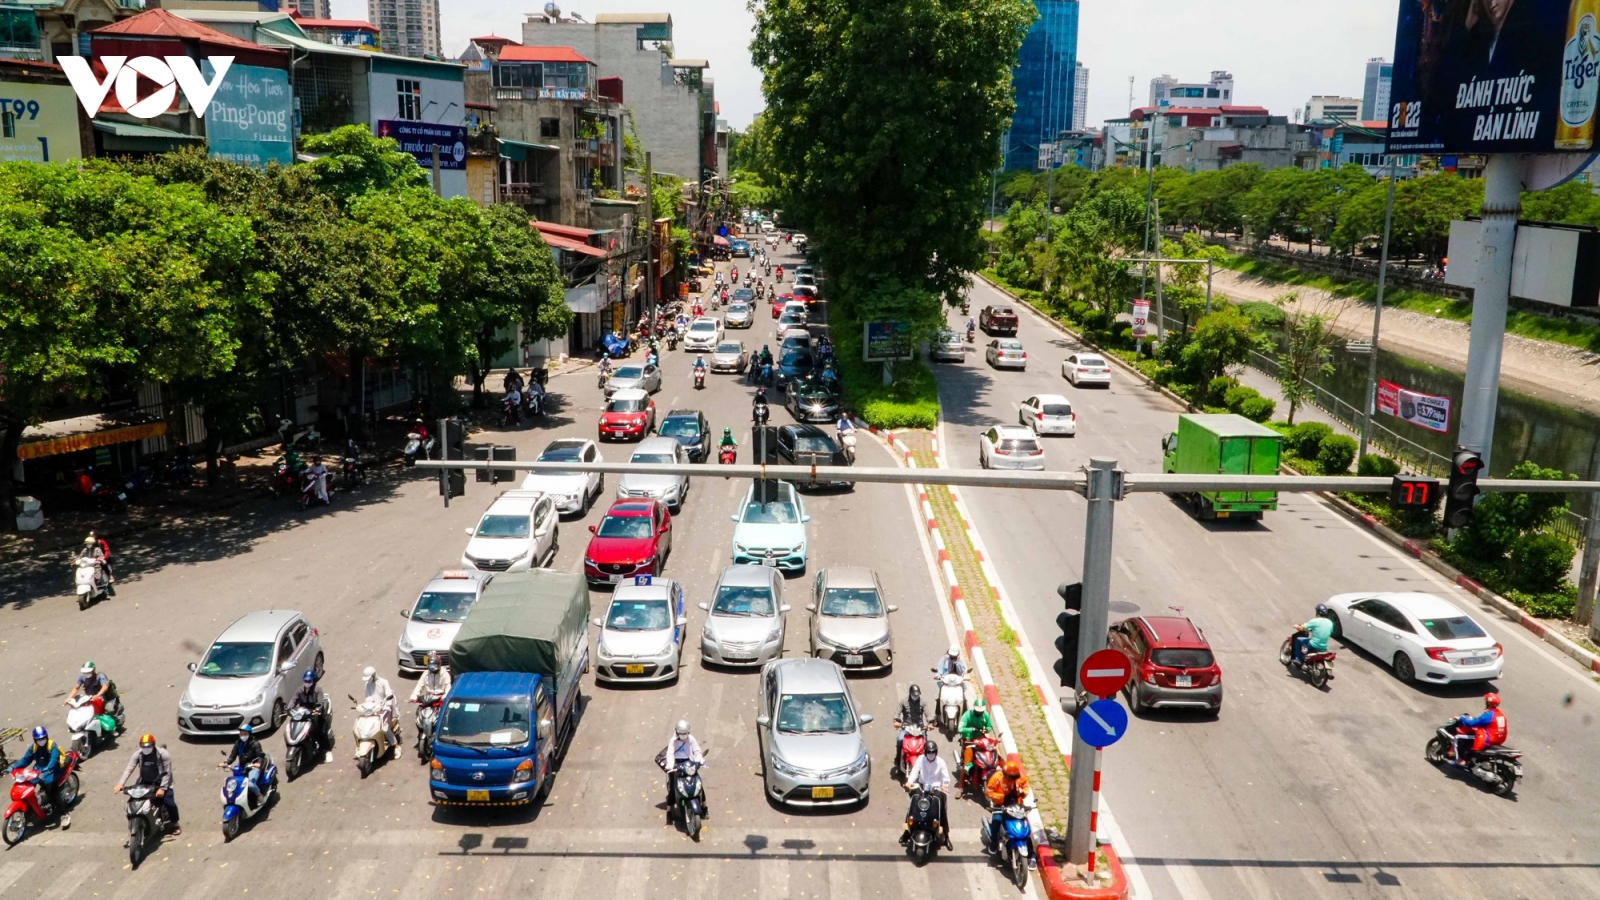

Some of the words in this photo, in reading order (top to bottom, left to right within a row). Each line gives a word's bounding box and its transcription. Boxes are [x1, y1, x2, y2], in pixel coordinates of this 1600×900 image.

[1564, 54, 1600, 89] Tiger
[1455, 75, 1495, 109] ĐÁNH
[1494, 69, 1535, 105] THỨC
[0, 98, 40, 120] T99
[210, 100, 287, 132] PingPong
[1566, 100, 1589, 108] CRYSTAL
[1472, 105, 1505, 141] BẢN
[1502, 106, 1540, 140] LĨNH
[37, 136, 49, 162] 1
[1134, 317, 1146, 326] 30
[1401, 482, 1428, 504] 77
